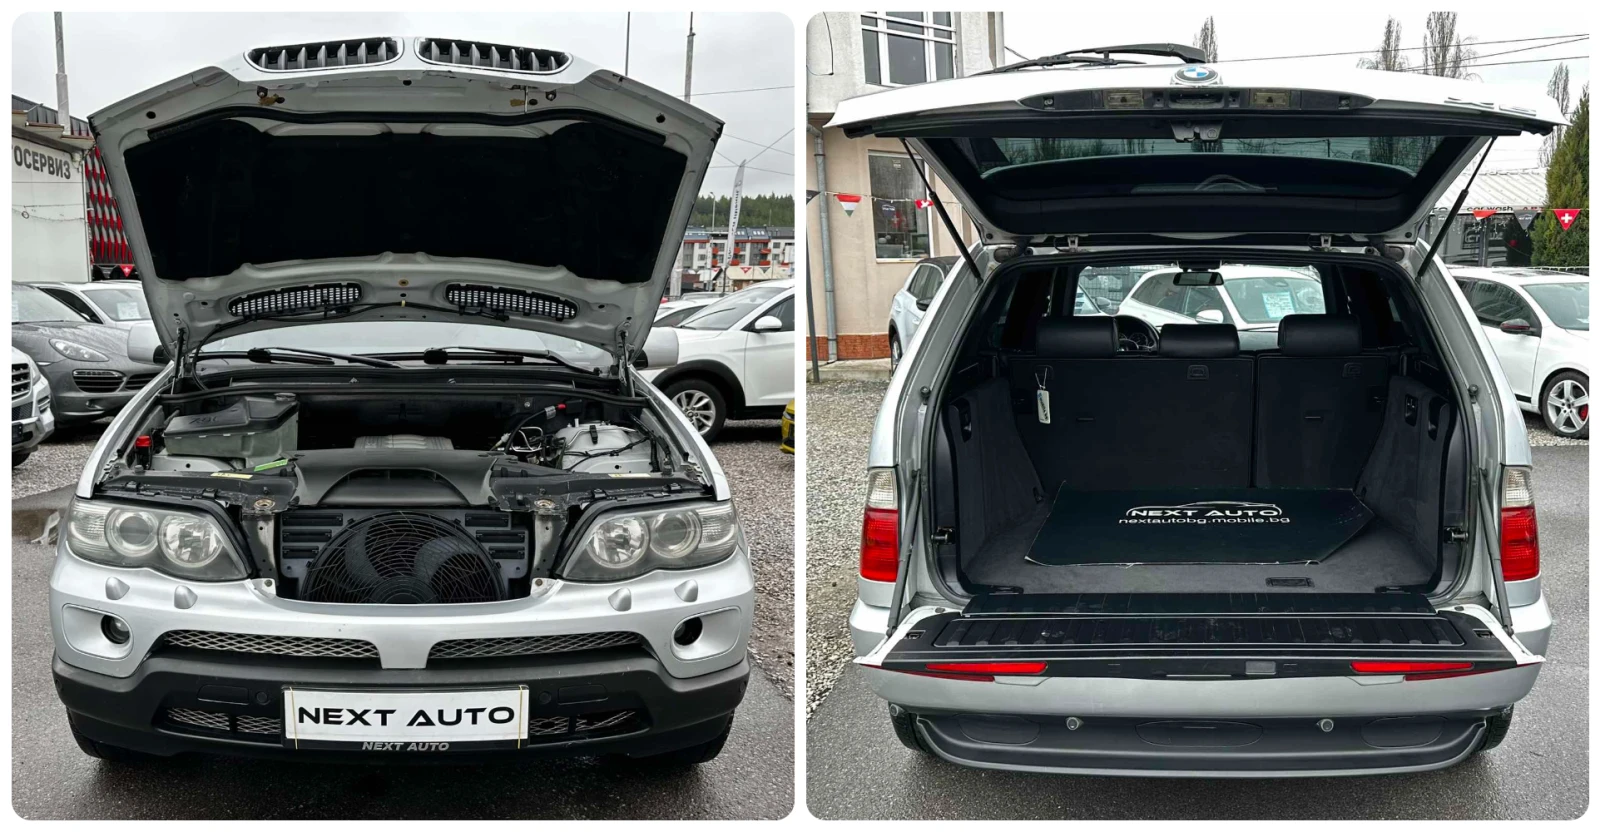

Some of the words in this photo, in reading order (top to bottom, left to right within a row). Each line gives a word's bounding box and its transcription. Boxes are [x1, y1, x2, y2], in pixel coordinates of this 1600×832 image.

[12, 144, 71, 180] ОСЕРВИЗ
[1118, 517, 1291, 525] nextautobg.mobile.bg
[298, 706, 397, 727] NEXT
[406, 706, 515, 727] AUTO
[362, 741, 404, 751] NEXT
[407, 742, 450, 752] AUTO
